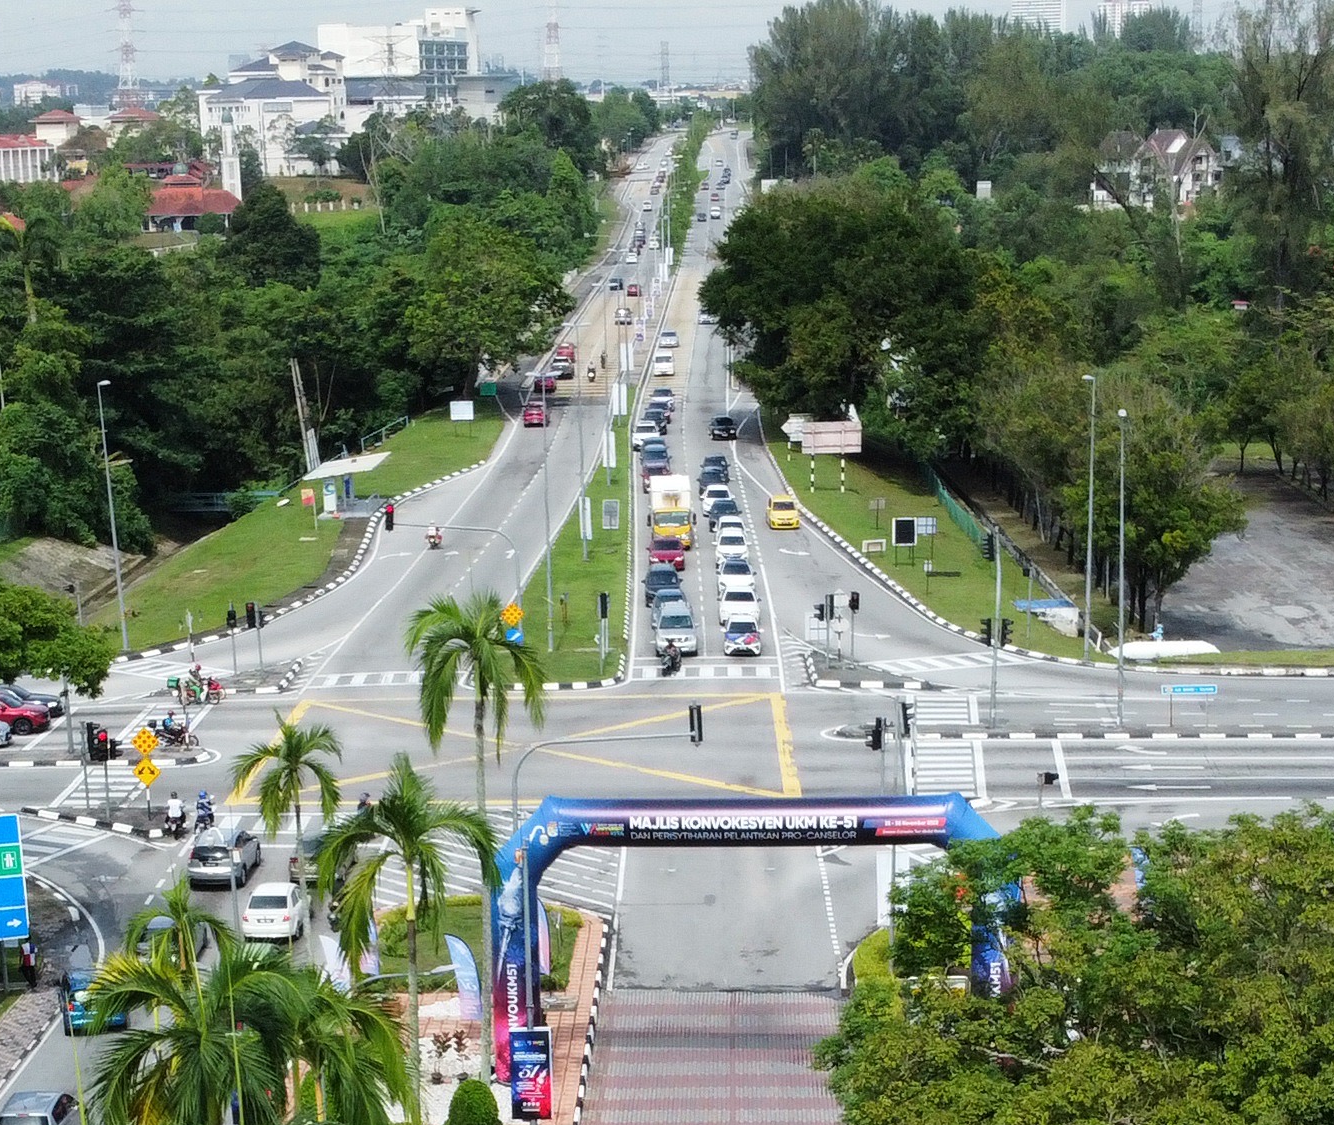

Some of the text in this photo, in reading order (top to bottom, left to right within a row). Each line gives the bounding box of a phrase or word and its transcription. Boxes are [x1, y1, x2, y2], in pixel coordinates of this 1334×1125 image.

[629, 816, 679, 830] MAJLIS
[681, 816, 783, 830] KONVOKESYEN
[786, 815, 817, 829] UKM
[820, 815, 858, 829] KE-51
[630, 831, 651, 840] DAN
[724, 831, 780, 840] PELANTIKAN
[506, 963, 519, 1030] NVOUKM51
